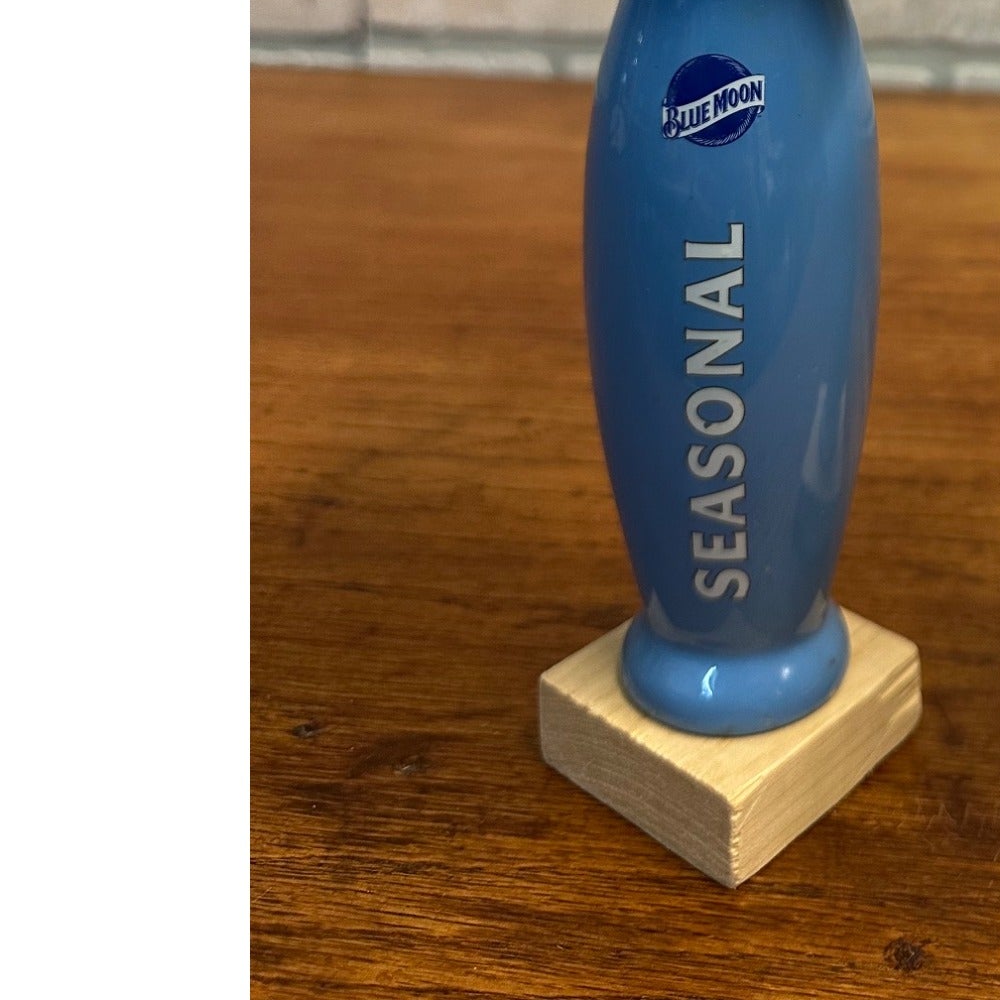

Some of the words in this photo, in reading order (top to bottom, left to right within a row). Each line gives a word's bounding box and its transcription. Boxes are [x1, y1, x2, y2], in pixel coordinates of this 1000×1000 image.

[663, 101, 711, 139] BLUE
[712, 80, 763, 119] MOON
[684, 222, 750, 600] SEASONAL
